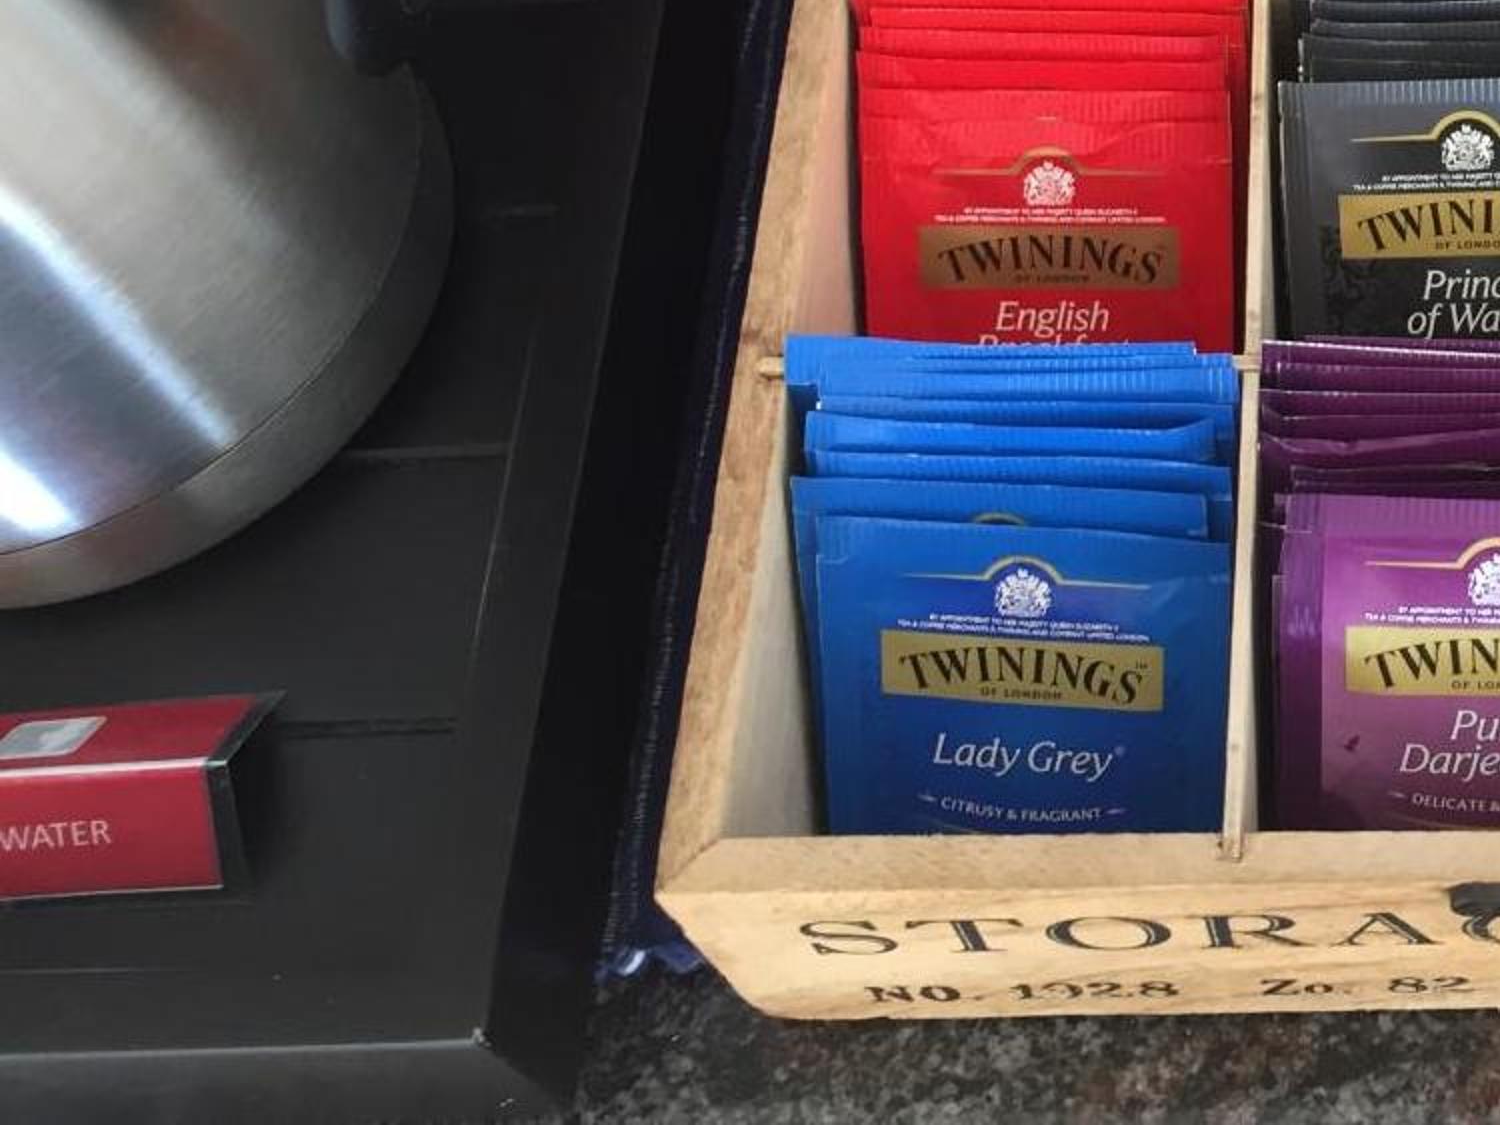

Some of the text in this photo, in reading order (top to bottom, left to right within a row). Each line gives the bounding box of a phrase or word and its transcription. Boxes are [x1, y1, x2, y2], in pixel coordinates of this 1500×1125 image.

[938, 233, 1163, 284] TWININGS
[995, 300, 1110, 339] English
[1406, 302, 1443, 340] of
[899, 645, 1144, 706] TWININGS
[1451, 680, 1470, 691] OF
[932, 732, 1114, 783] Lady Grey
[940, 795, 1103, 823] CITRUSY & FRAGRANT
[1412, 792, 1487, 812] DELICATE
[1489, 800, 1500, 813] &
[0, 820, 112, 853] WATER
[1387, 976, 1475, 993] 82
